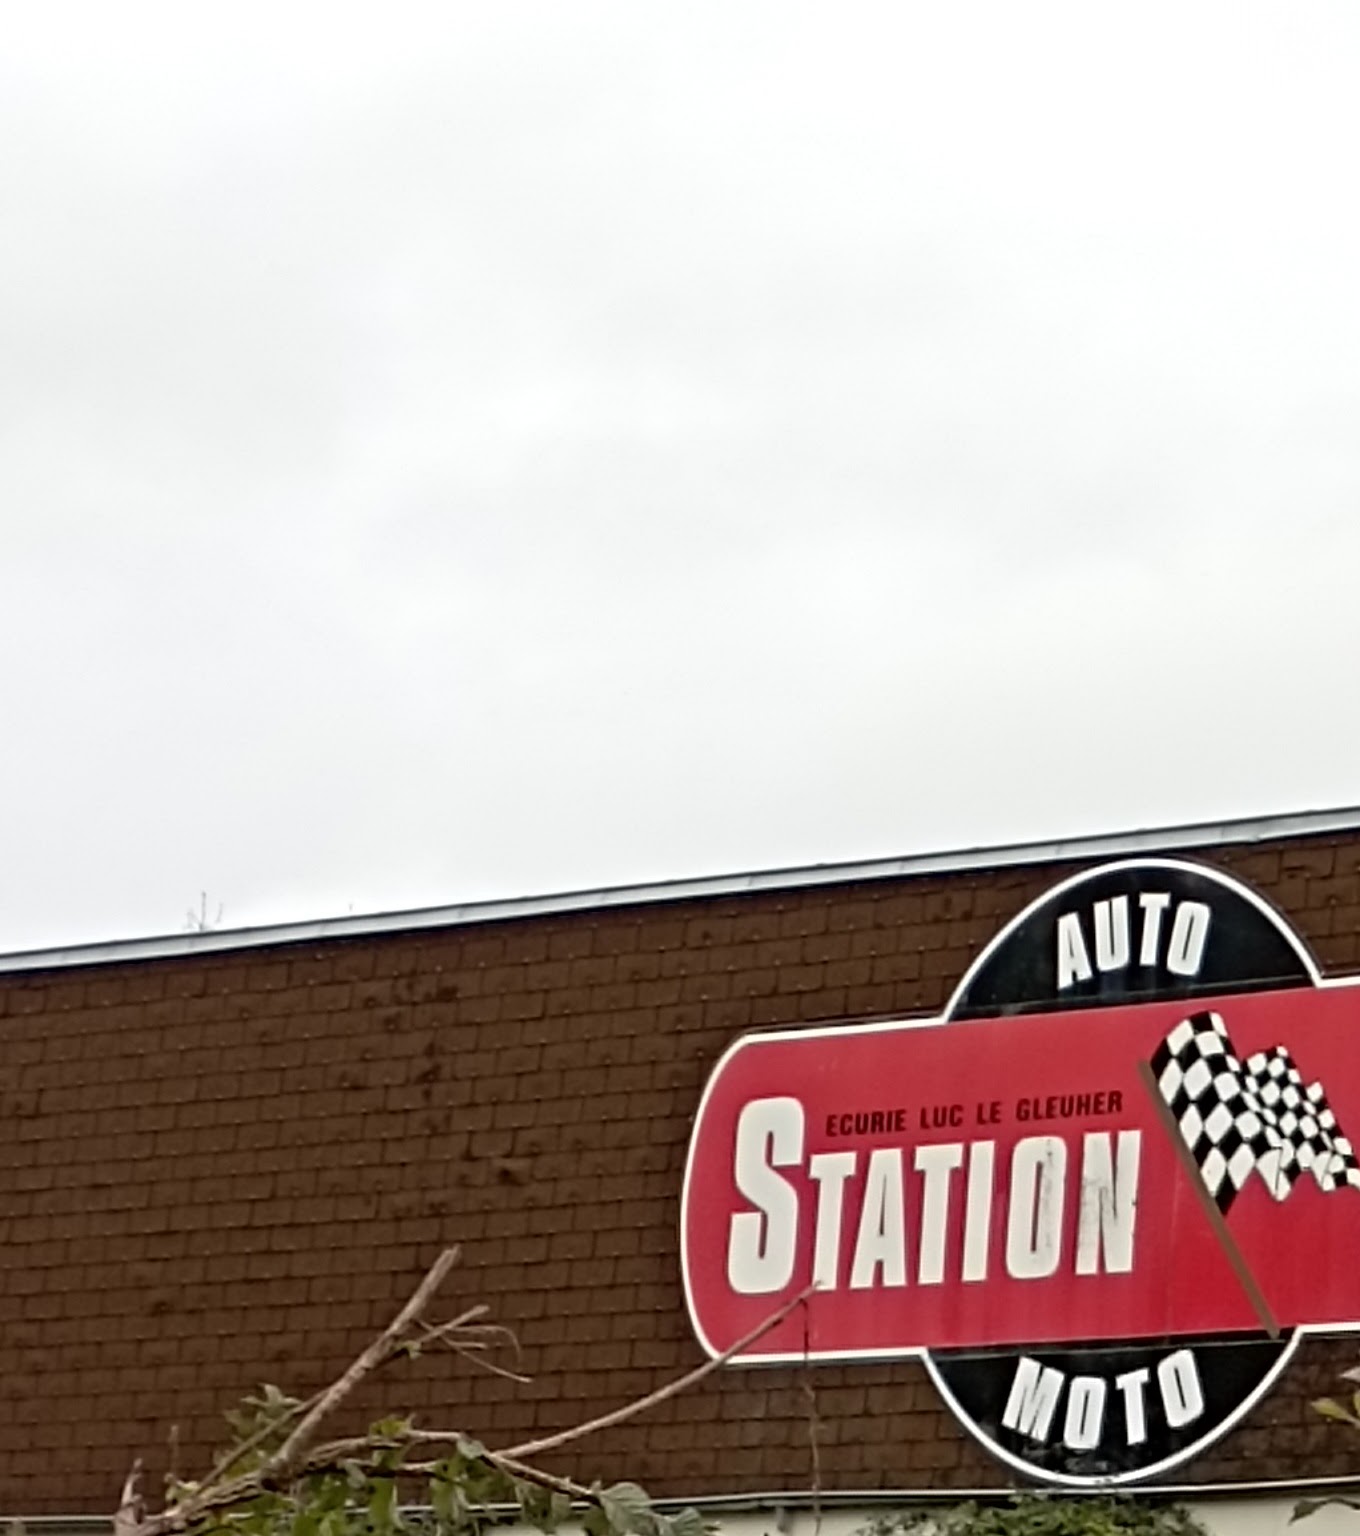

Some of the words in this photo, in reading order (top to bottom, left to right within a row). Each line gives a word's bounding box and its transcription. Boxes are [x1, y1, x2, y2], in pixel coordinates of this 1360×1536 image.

[1055, 891, 1212, 990] AUTO
[824, 1108, 908, 1138] ECURIE
[918, 1103, 965, 1130] LUC
[974, 1101, 1003, 1126] LE
[1014, 1089, 1124, 1122] GLEUHER
[727, 1096, 1142, 1294] STATION
[1000, 1348, 1205, 1452] MOTO
